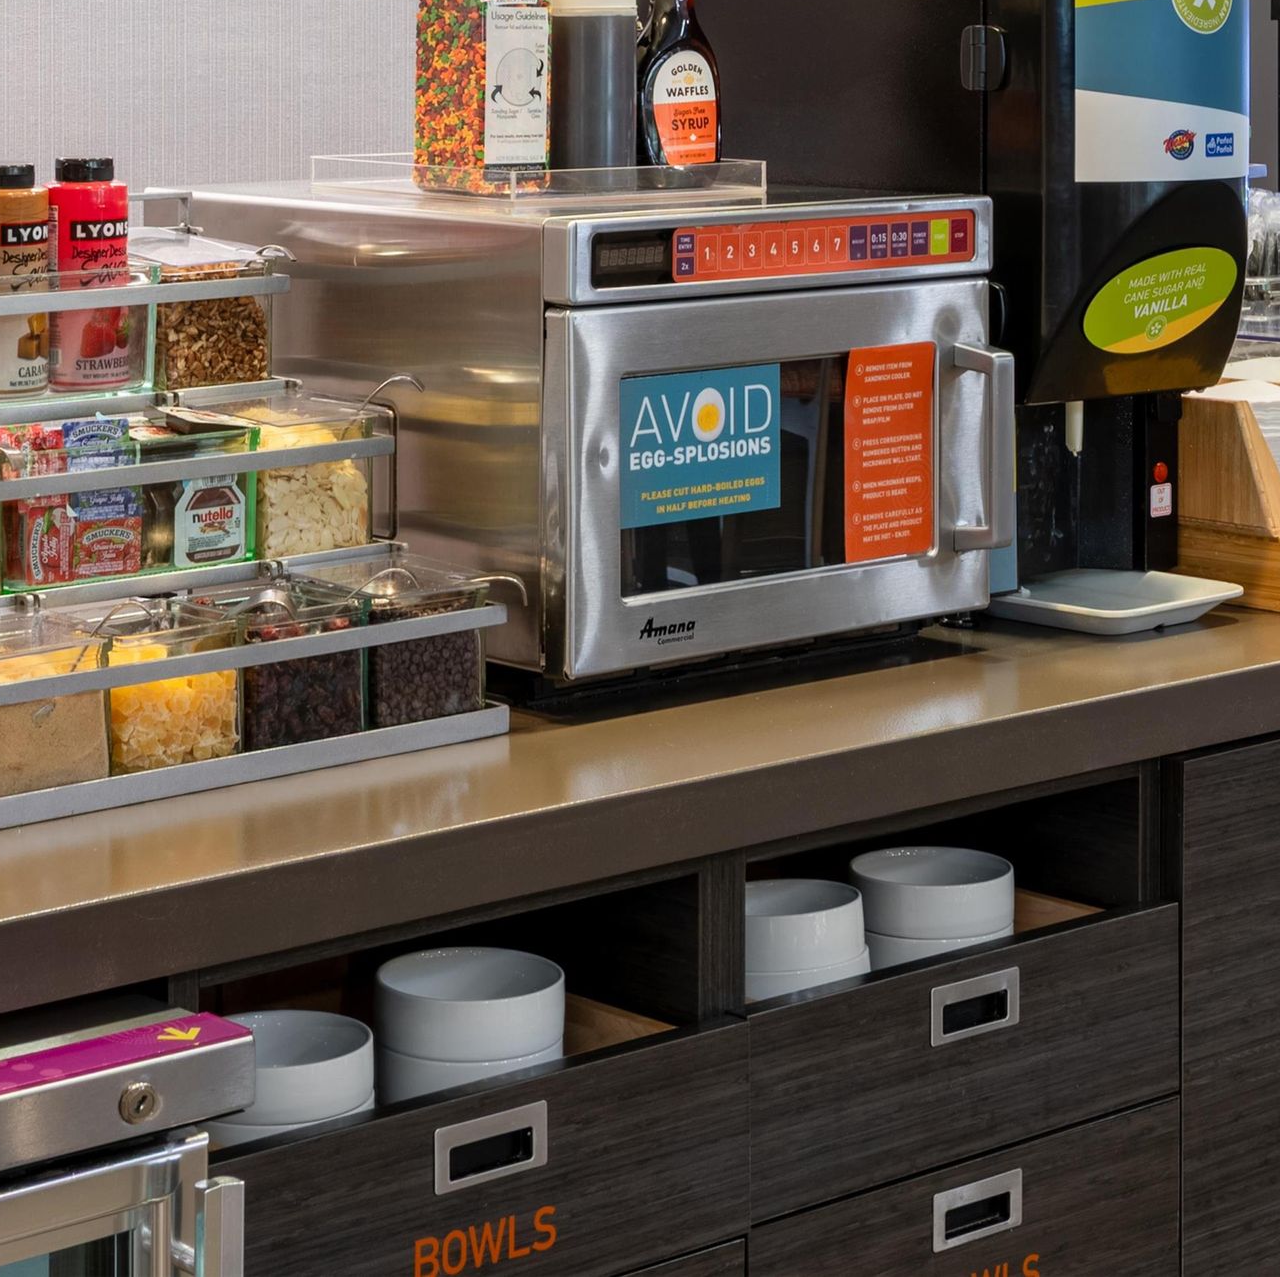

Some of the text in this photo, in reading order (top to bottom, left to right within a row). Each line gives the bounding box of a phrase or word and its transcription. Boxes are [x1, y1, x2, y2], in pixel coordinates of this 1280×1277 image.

[491, 11, 514, 22] Usage
[671, 63, 702, 76] GOLDEN
[666, 85, 709, 97] WAFFLES
[671, 117, 709, 131] SYRUP
[871, 233, 887, 243] 0:15
[892, 232, 907, 242] 0:30
[748, 244, 755, 257] 3
[770, 242, 777, 256] 4
[792, 240, 799, 254] 5
[813, 239, 819, 252] 6
[834, 237, 841, 251] 7
[704, 247, 710, 260] 1
[727, 245, 733, 259] 2
[681, 262, 689, 270] 2x
[1128, 262, 1207, 289] MADE WITH REAL
[1124, 276, 1205, 304] CANE SUGAR AND
[1134, 294, 1188, 319] VANILLA
[865, 364, 885, 372] REMOVE
[864, 374, 890, 383] SANDWICH
[863, 396, 879, 404] PLACE
[863, 406, 882, 414] REMOVE
[883, 404, 897, 412] FROM
[629, 384, 772, 448] AVOID
[880, 433, 922, 444] CORRESPONDING
[630, 436, 771, 471] EGG-SPLOSIONS
[891, 445, 910, 454] BUTTON
[911, 443, 922, 451] AND
[863, 458, 892, 467] MICROWAVE
[641, 477, 765, 501] PLEASE CUT HARD-BOILED EGGS
[863, 481, 877, 489] WHEN
[863, 491, 885, 500] PRODUCT
[656, 494, 751, 514] IN HALF BEFORE HEATING
[192, 507, 234, 523] nutella
[863, 512, 884, 521] REMOVE
[885, 508, 914, 519] CAREFULLY
[873, 522, 888, 530] PLATE
[900, 518, 922, 527] PRODUCT
[639, 617, 696, 640] Amana
[657, 633, 694, 645] Commercial
[414, 1205, 558, 1277] BOWLS
